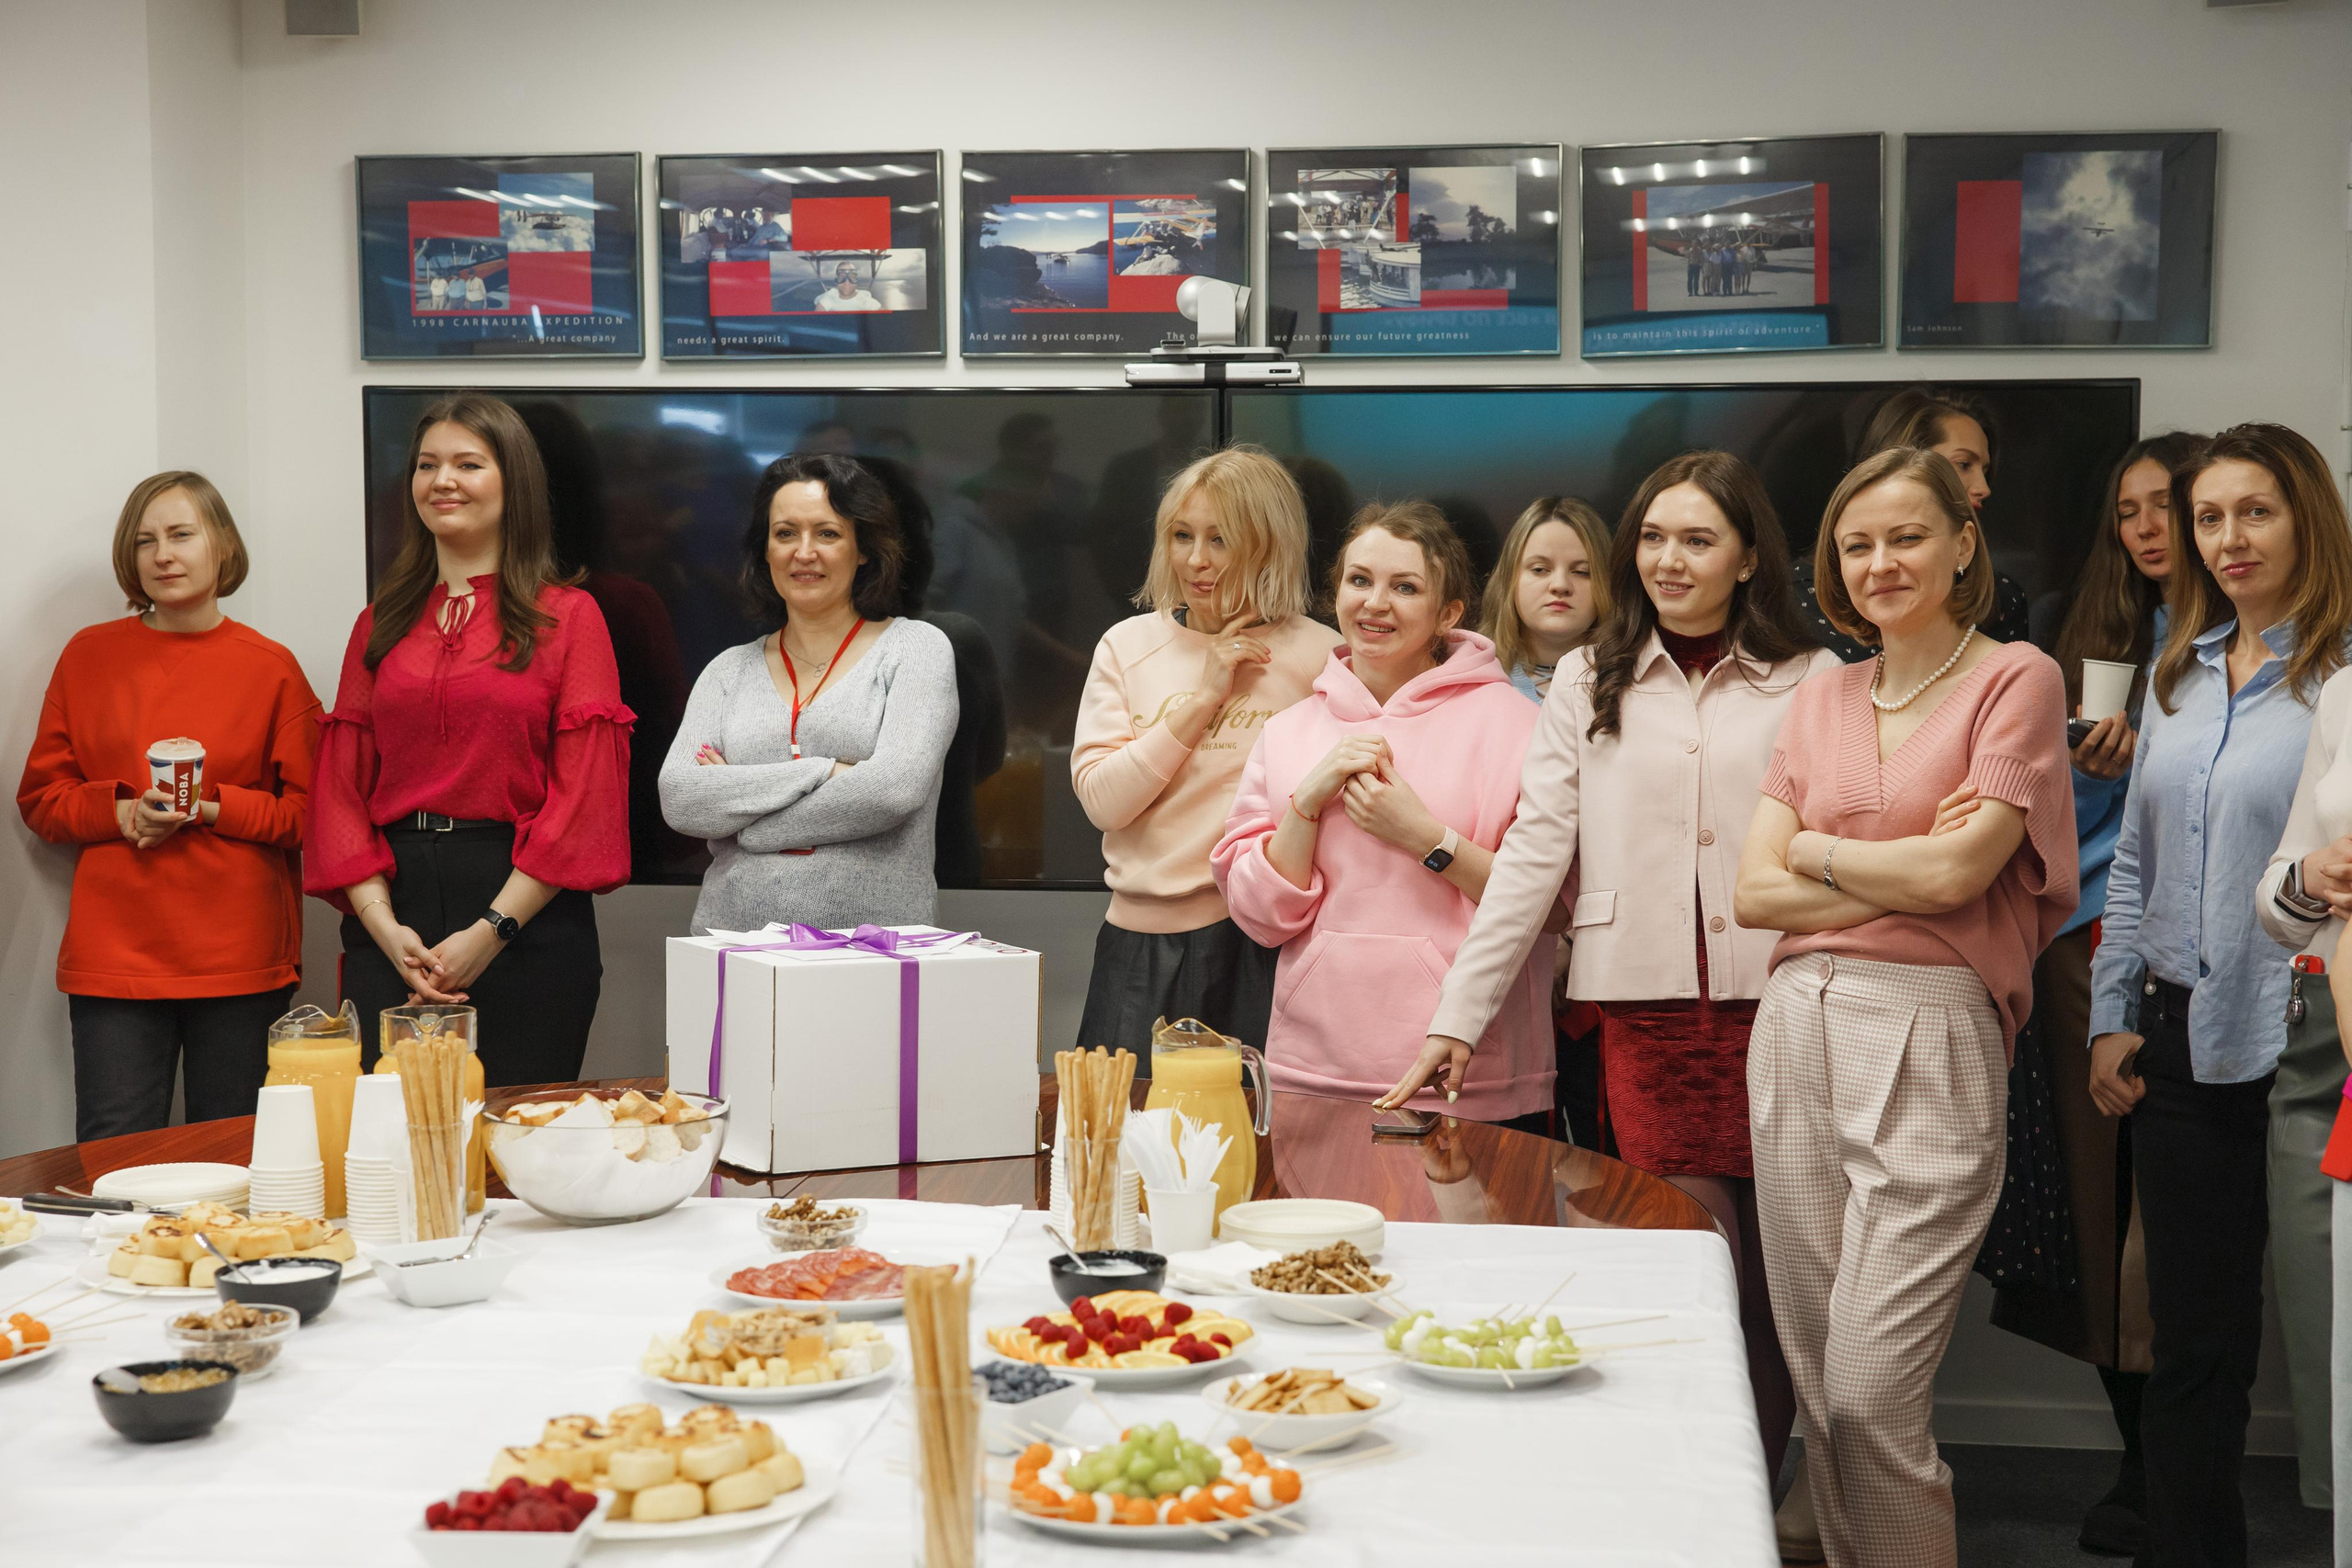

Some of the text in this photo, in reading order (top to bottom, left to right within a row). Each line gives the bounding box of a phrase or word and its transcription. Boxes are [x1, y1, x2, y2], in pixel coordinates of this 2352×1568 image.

[412, 316, 624, 327] 1998 CARNAUBA XPEDITION
[1593, 333, 1602, 341] is
[1607, 332, 1618, 340] to
[1623, 330, 1671, 340] maintain
[1677, 329, 1698, 338] this
[1702, 327, 1733, 338] spirit
[1738, 327, 1749, 336] of
[1928, 324, 1962, 333] Johnson
[539, 334, 567, 344] great
[571, 334, 616, 344] company
[677, 335, 707, 344] needs
[720, 335, 749, 346] great
[752, 334, 786, 345] spirit.
[969, 332, 989, 341] And
[1042, 333, 1070, 343] great
[1074, 333, 1125, 343] company.
[1166, 332, 1185, 340] The
[1273, 332, 1469, 343] we can ensure our future greatness
[1200, 742, 1238, 751] DREAMING
[178, 772, 189, 807] NOBA
